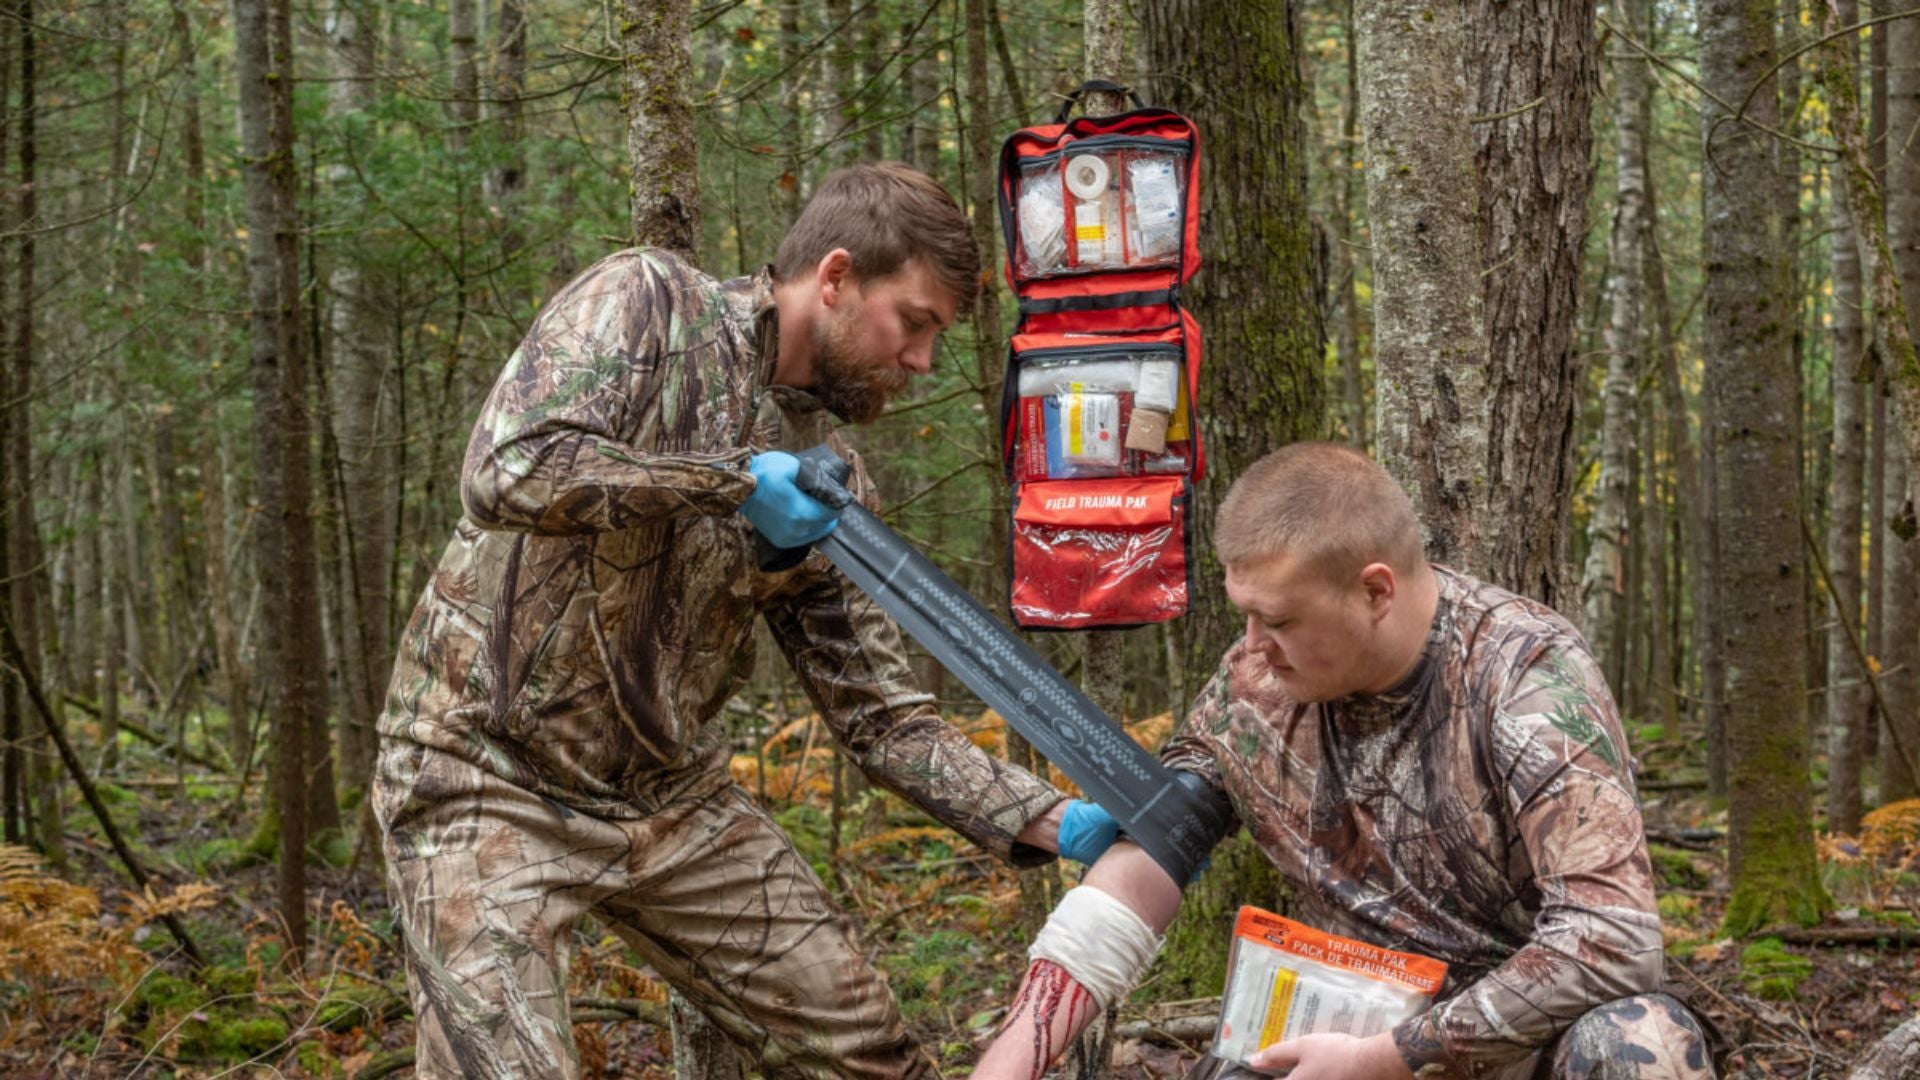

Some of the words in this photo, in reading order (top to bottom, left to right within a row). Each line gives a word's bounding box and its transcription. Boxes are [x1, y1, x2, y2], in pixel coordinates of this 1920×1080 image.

[1045, 496, 1076, 511] FIELD
[1080, 495, 1122, 509] TRAUMA
[1126, 495, 1148, 509] PAK
[1293, 940, 1324, 960] PACK
[1327, 952, 1344, 965] DE
[1350, 957, 1436, 990] TRAUMATISME
[1327, 939, 1378, 961] TRAUMA
[1382, 953, 1407, 969] PAK
